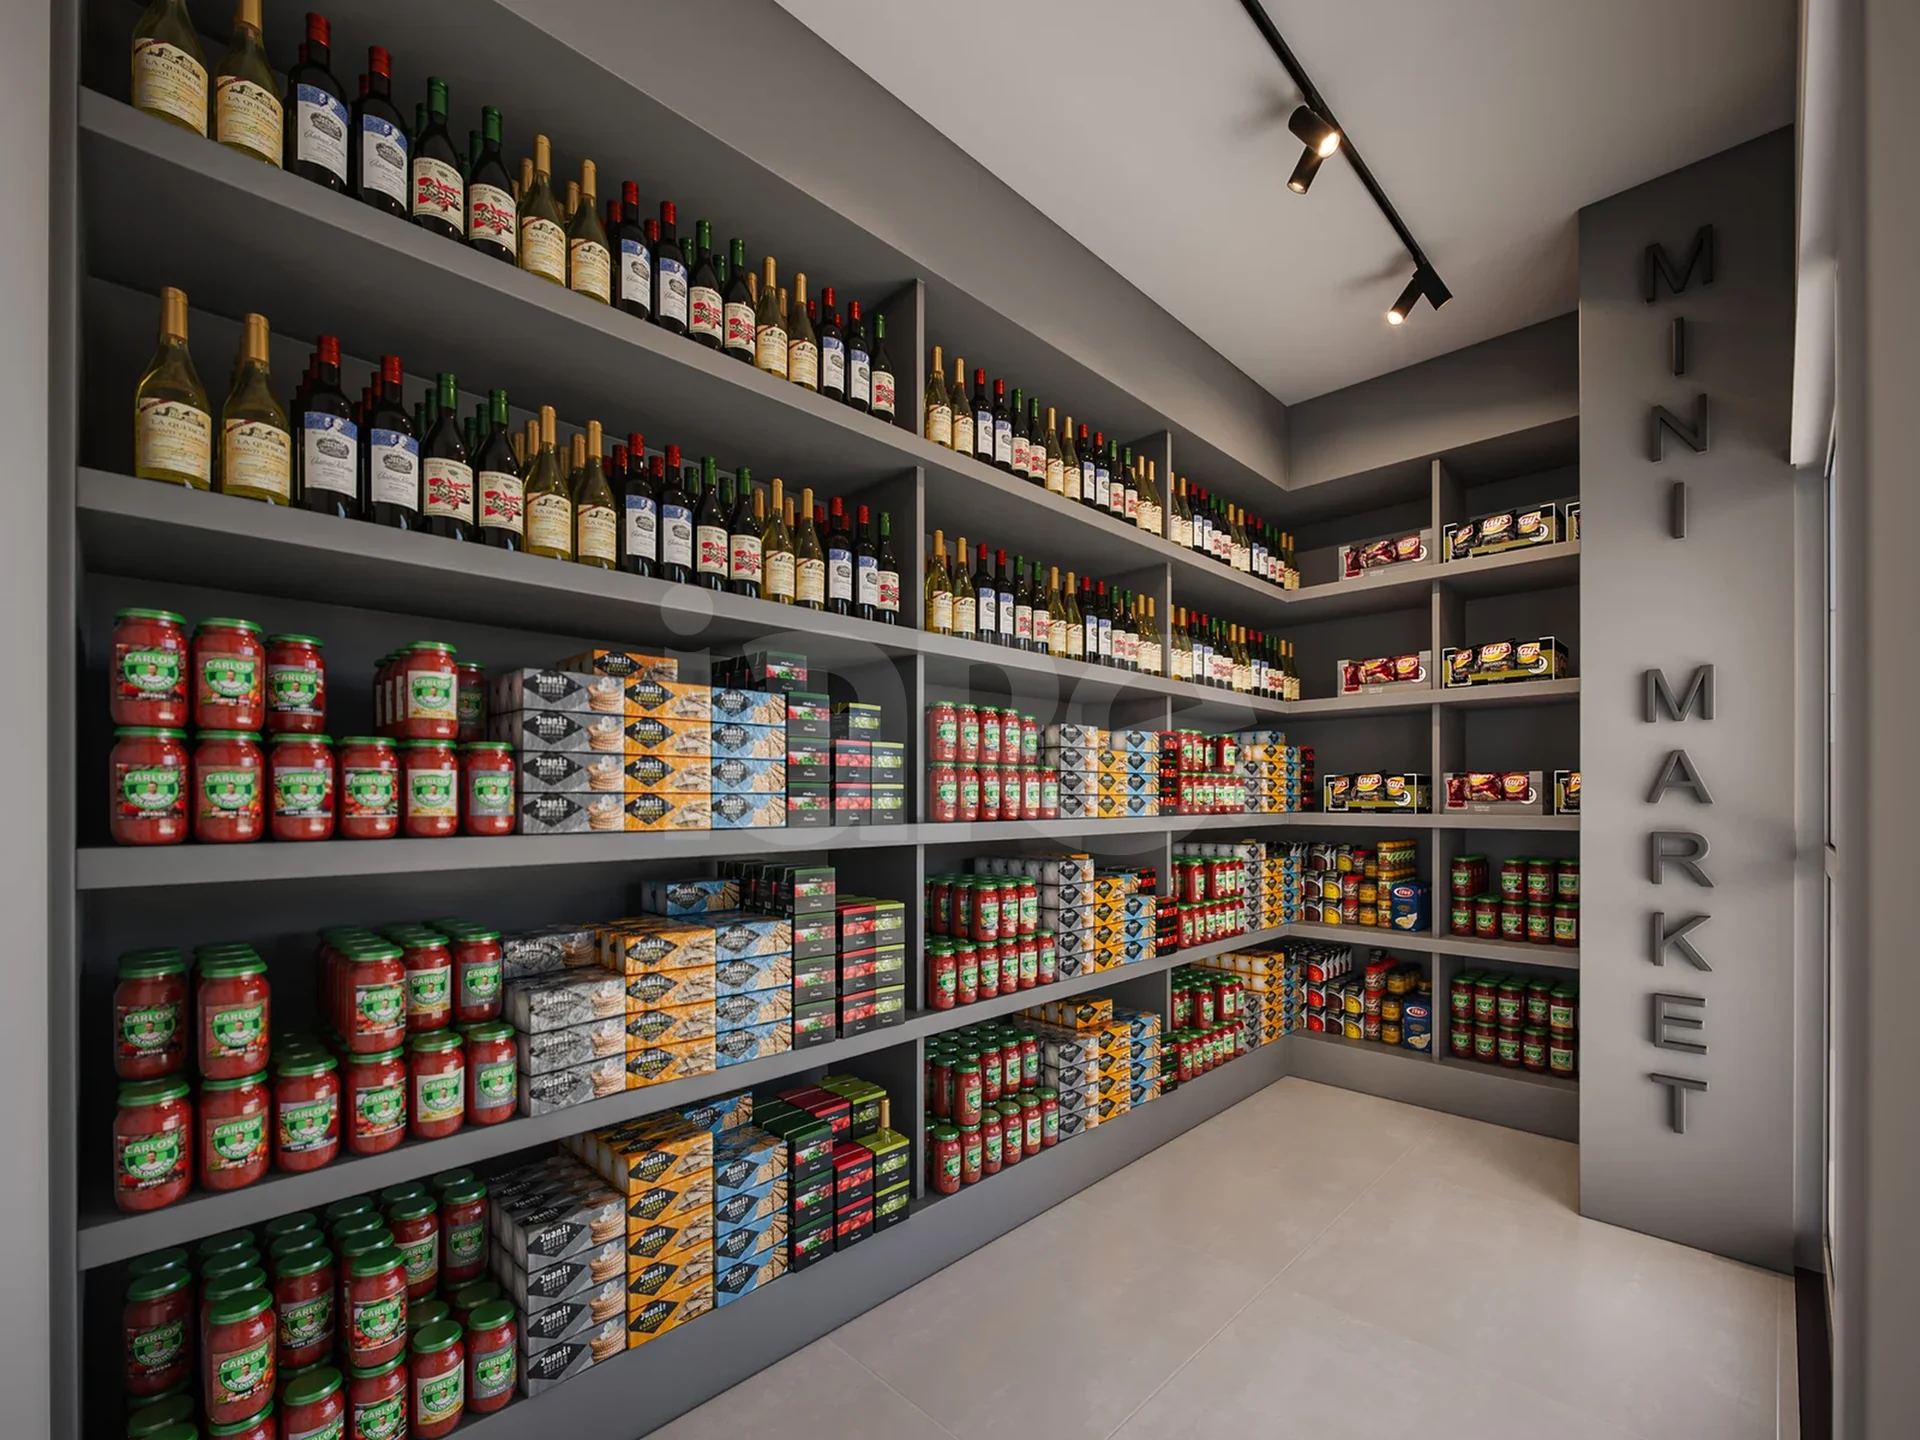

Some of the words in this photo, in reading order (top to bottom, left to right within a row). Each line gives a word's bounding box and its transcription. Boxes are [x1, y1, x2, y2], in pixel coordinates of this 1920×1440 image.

[1644, 224, 1714, 539] MINI
[125, 651, 176, 666] CARLOS
[206, 660, 252, 671] CARLOS
[274, 672, 315, 683] CARLOS
[125, 771, 176, 783] CARLOS
[206, 772, 252, 784] CARLOS
[281, 774, 323, 785] CARLOS
[352, 776, 391, 786] CARLOS
[1644, 664, 1716, 1134] MARKET
[411, 973, 446, 985] CARLOS
[124, 1009, 173, 1025] CARLOS
[213, 1007, 260, 1024] CARLOS
[480, 1066, 513, 1079] CARLOS
[423, 1077, 459, 1091] CARLOS
[364, 1089, 401, 1104] CARLOS
[286, 1104, 328, 1121] CARLOS
[214, 1118, 261, 1136] CARLOS
[124, 1136, 176, 1155] CARLOS
[451, 1226, 484, 1241] CARLOS
[287, 1299, 328, 1320] CARLOS
[360, 1300, 399, 1319] CARLOS
[134, 1324, 180, 1346] CARLOS
[220, 1347, 266, 1370] CARLOS
[478, 1352, 513, 1370] CARLOS
[424, 1374, 461, 1394] CARLOS
[361, 1402, 399, 1423] CARLOS
